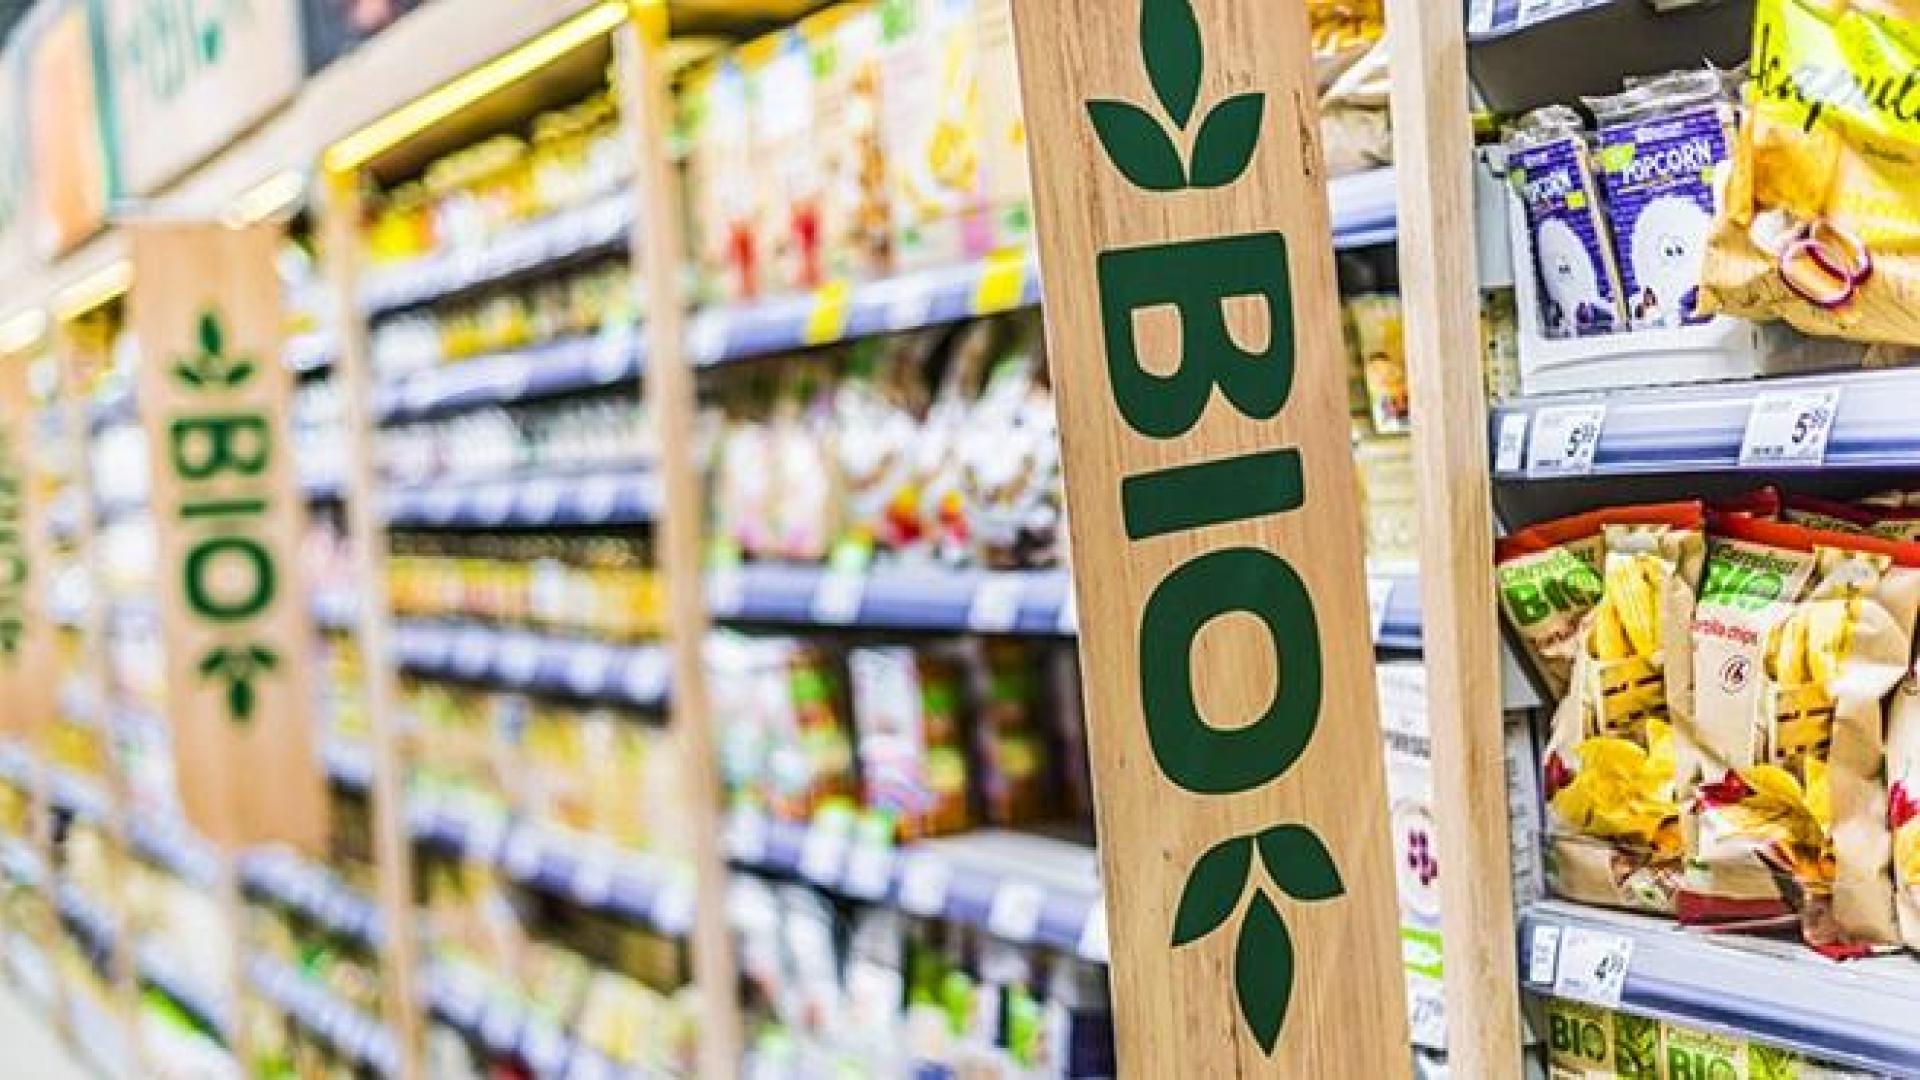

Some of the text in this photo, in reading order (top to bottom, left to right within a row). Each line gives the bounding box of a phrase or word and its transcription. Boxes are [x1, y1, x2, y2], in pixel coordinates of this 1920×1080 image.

[170, 414, 277, 622] BIO
[1096, 230, 1323, 794] BIO
[1504, 567, 1603, 627] BIO
[1703, 559, 1783, 610] BIO
[1550, 1014, 1606, 1063] BIO
[1668, 1047, 1736, 1080] BIO
